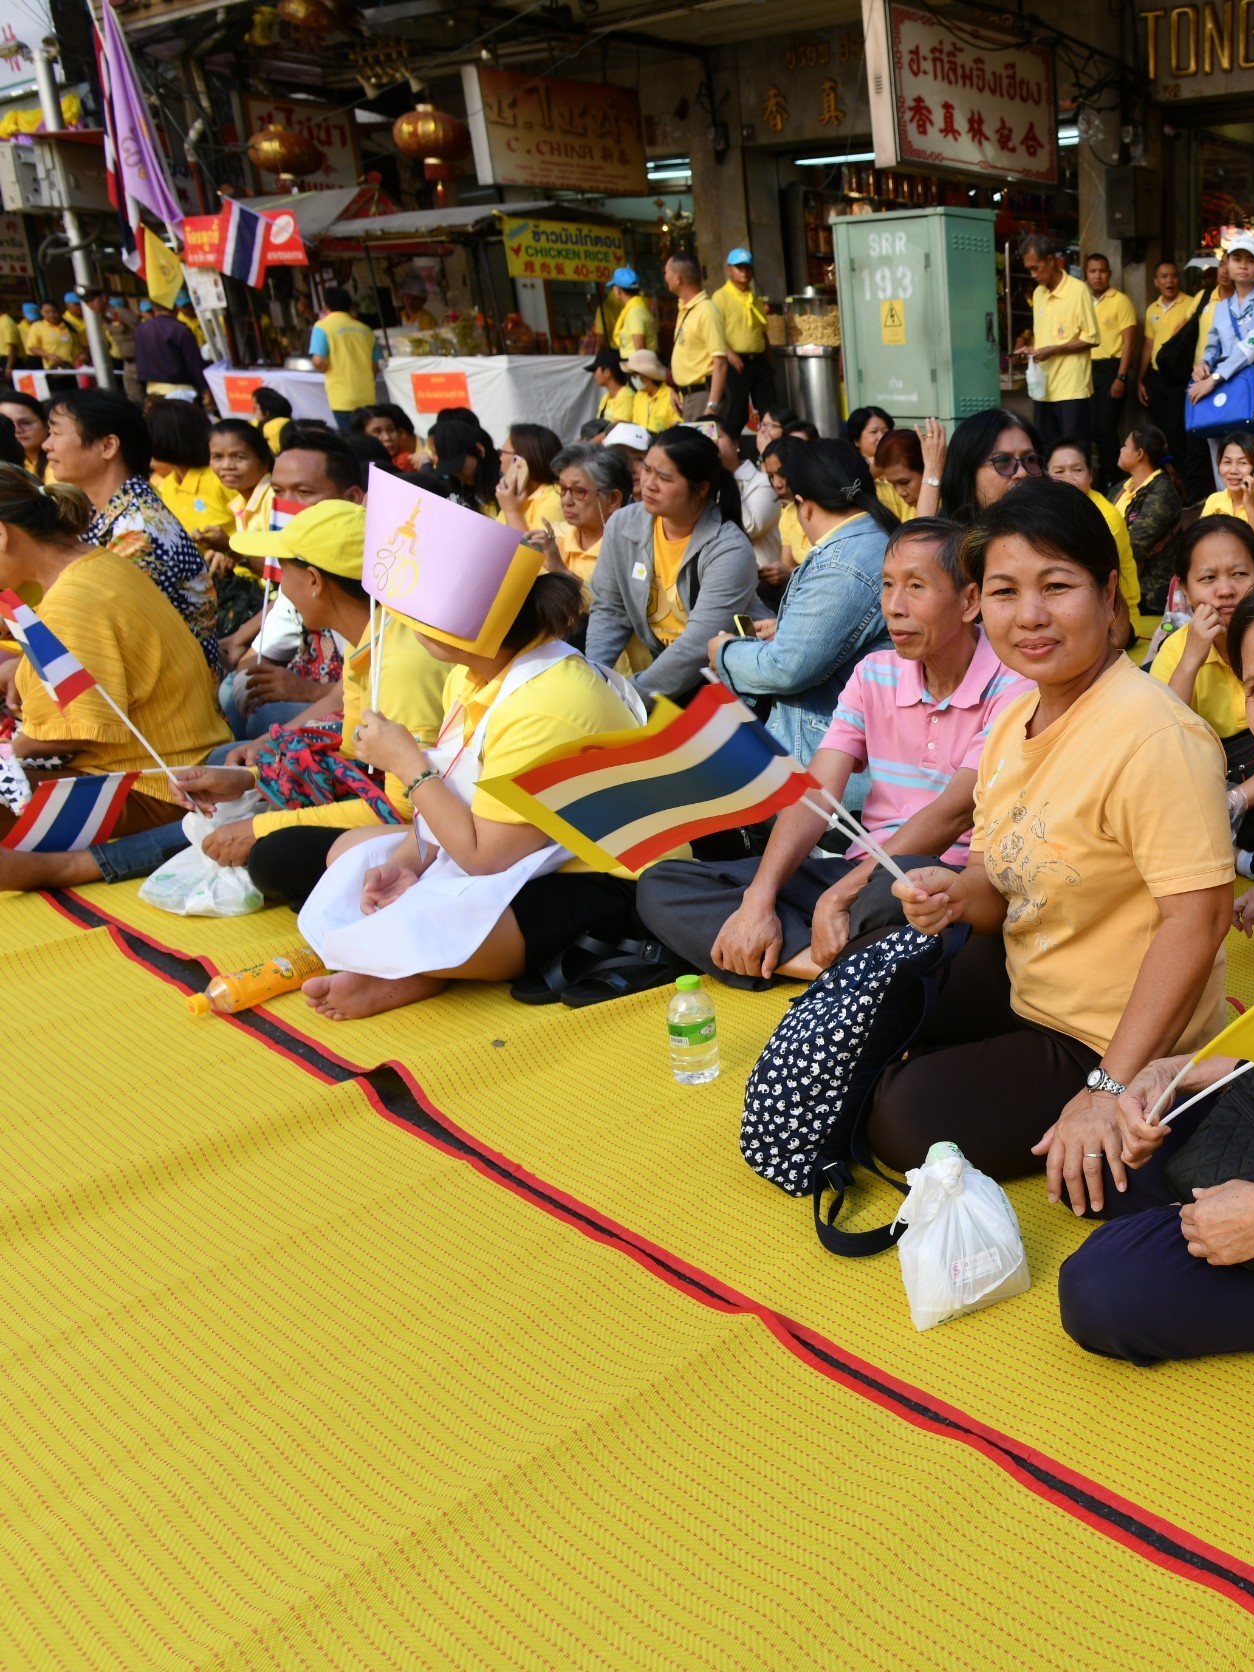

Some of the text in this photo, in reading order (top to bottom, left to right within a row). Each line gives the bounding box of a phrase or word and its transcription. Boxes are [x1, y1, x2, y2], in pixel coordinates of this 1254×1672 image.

[531, 224, 623, 249] ข้าวมันไก่ตอน
[868, 231, 907, 257] SRR
[525, 245, 611, 263] CHICKEN RICE
[861, 265, 914, 301] 193
